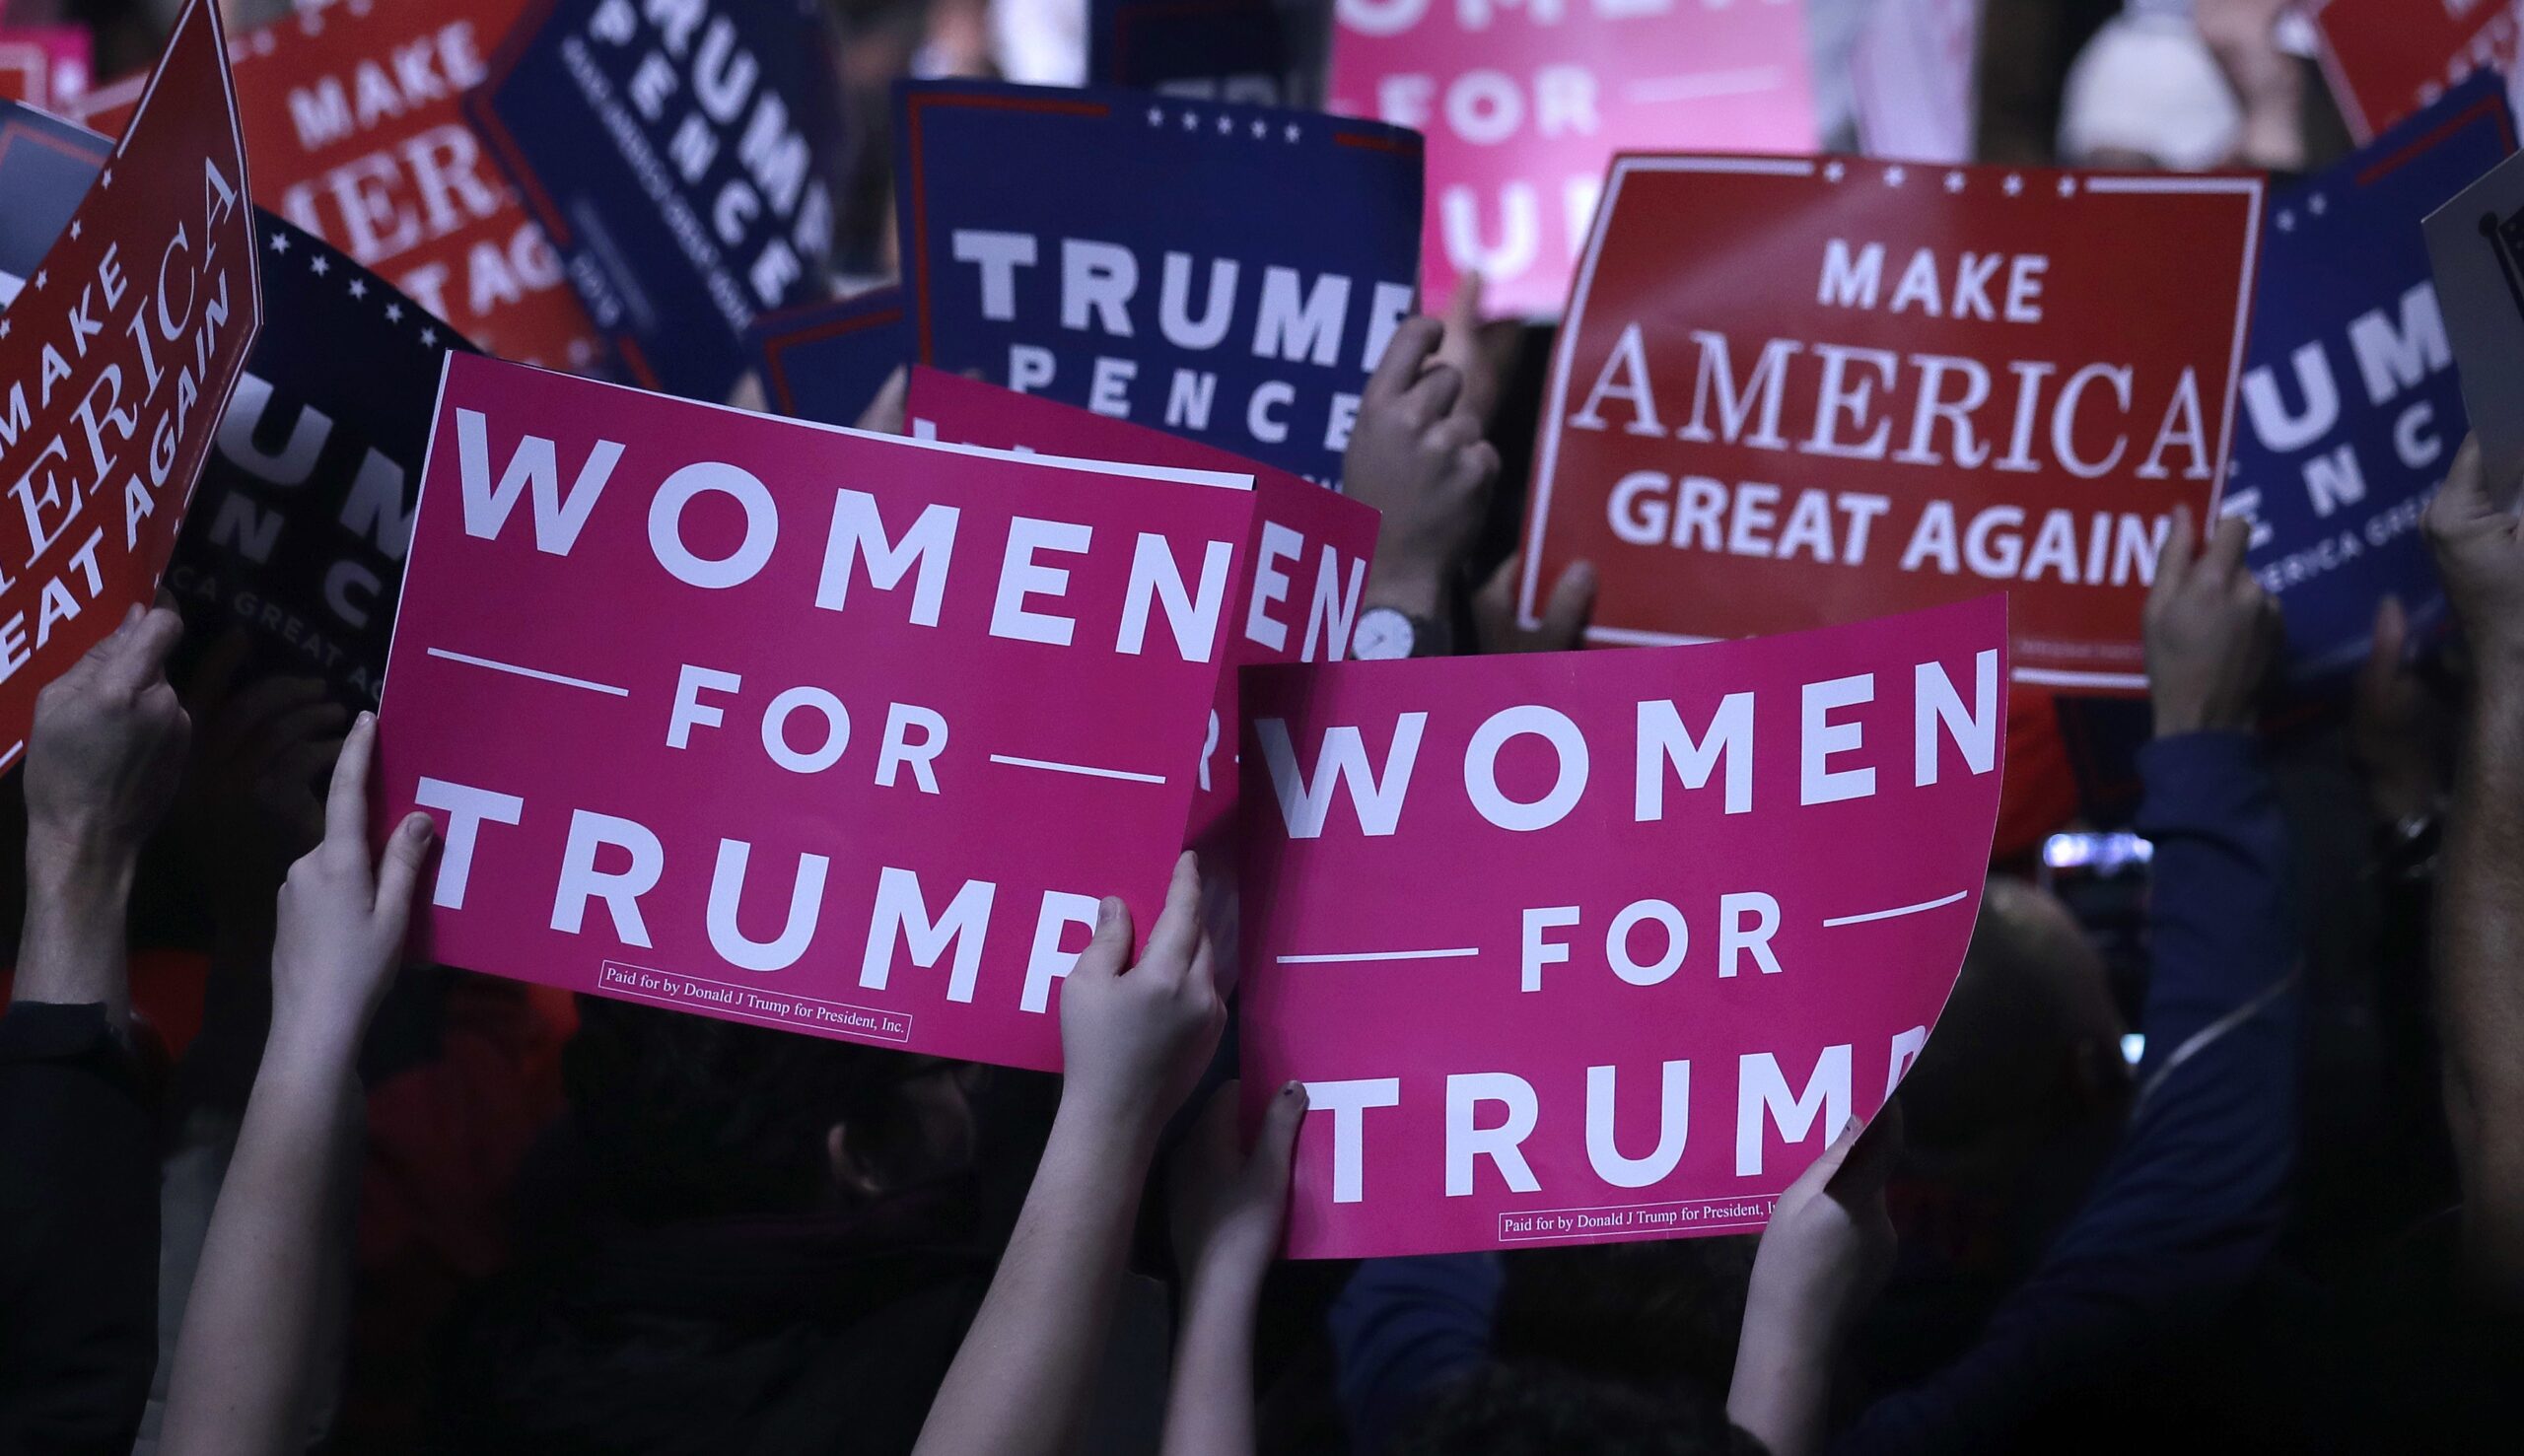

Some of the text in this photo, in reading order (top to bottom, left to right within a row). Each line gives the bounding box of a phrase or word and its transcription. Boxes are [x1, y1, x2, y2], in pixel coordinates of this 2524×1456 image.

[1817, 238, 2050, 323] MAKE
[0, 157, 237, 597] ERICA
[125, 268, 228, 554] AGAIN
[1568, 322, 2213, 481] AMERICA
[456, 407, 1233, 663] WOMEN
[1606, 469, 2170, 587] GREAT AGAIN
[666, 663, 949, 795] FOR
[1253, 649, 1998, 839] WOMEN
[414, 775, 1102, 1015] TRUMP
[1520, 890, 1783, 992] FOR
[606, 967, 905, 1034] Paid for by Donald J Trump for President, Inc.
[1505, 1218, 1532, 1232] Paid
[1536, 1216, 1556, 1230] for
[1558, 1215, 1574, 1231] by
[1578, 1213, 1623, 1228] Donald
[1636, 1211, 1677, 1225] Trump
[1681, 1208, 1700, 1221] for
[1703, 1202, 1764, 1218] President,
